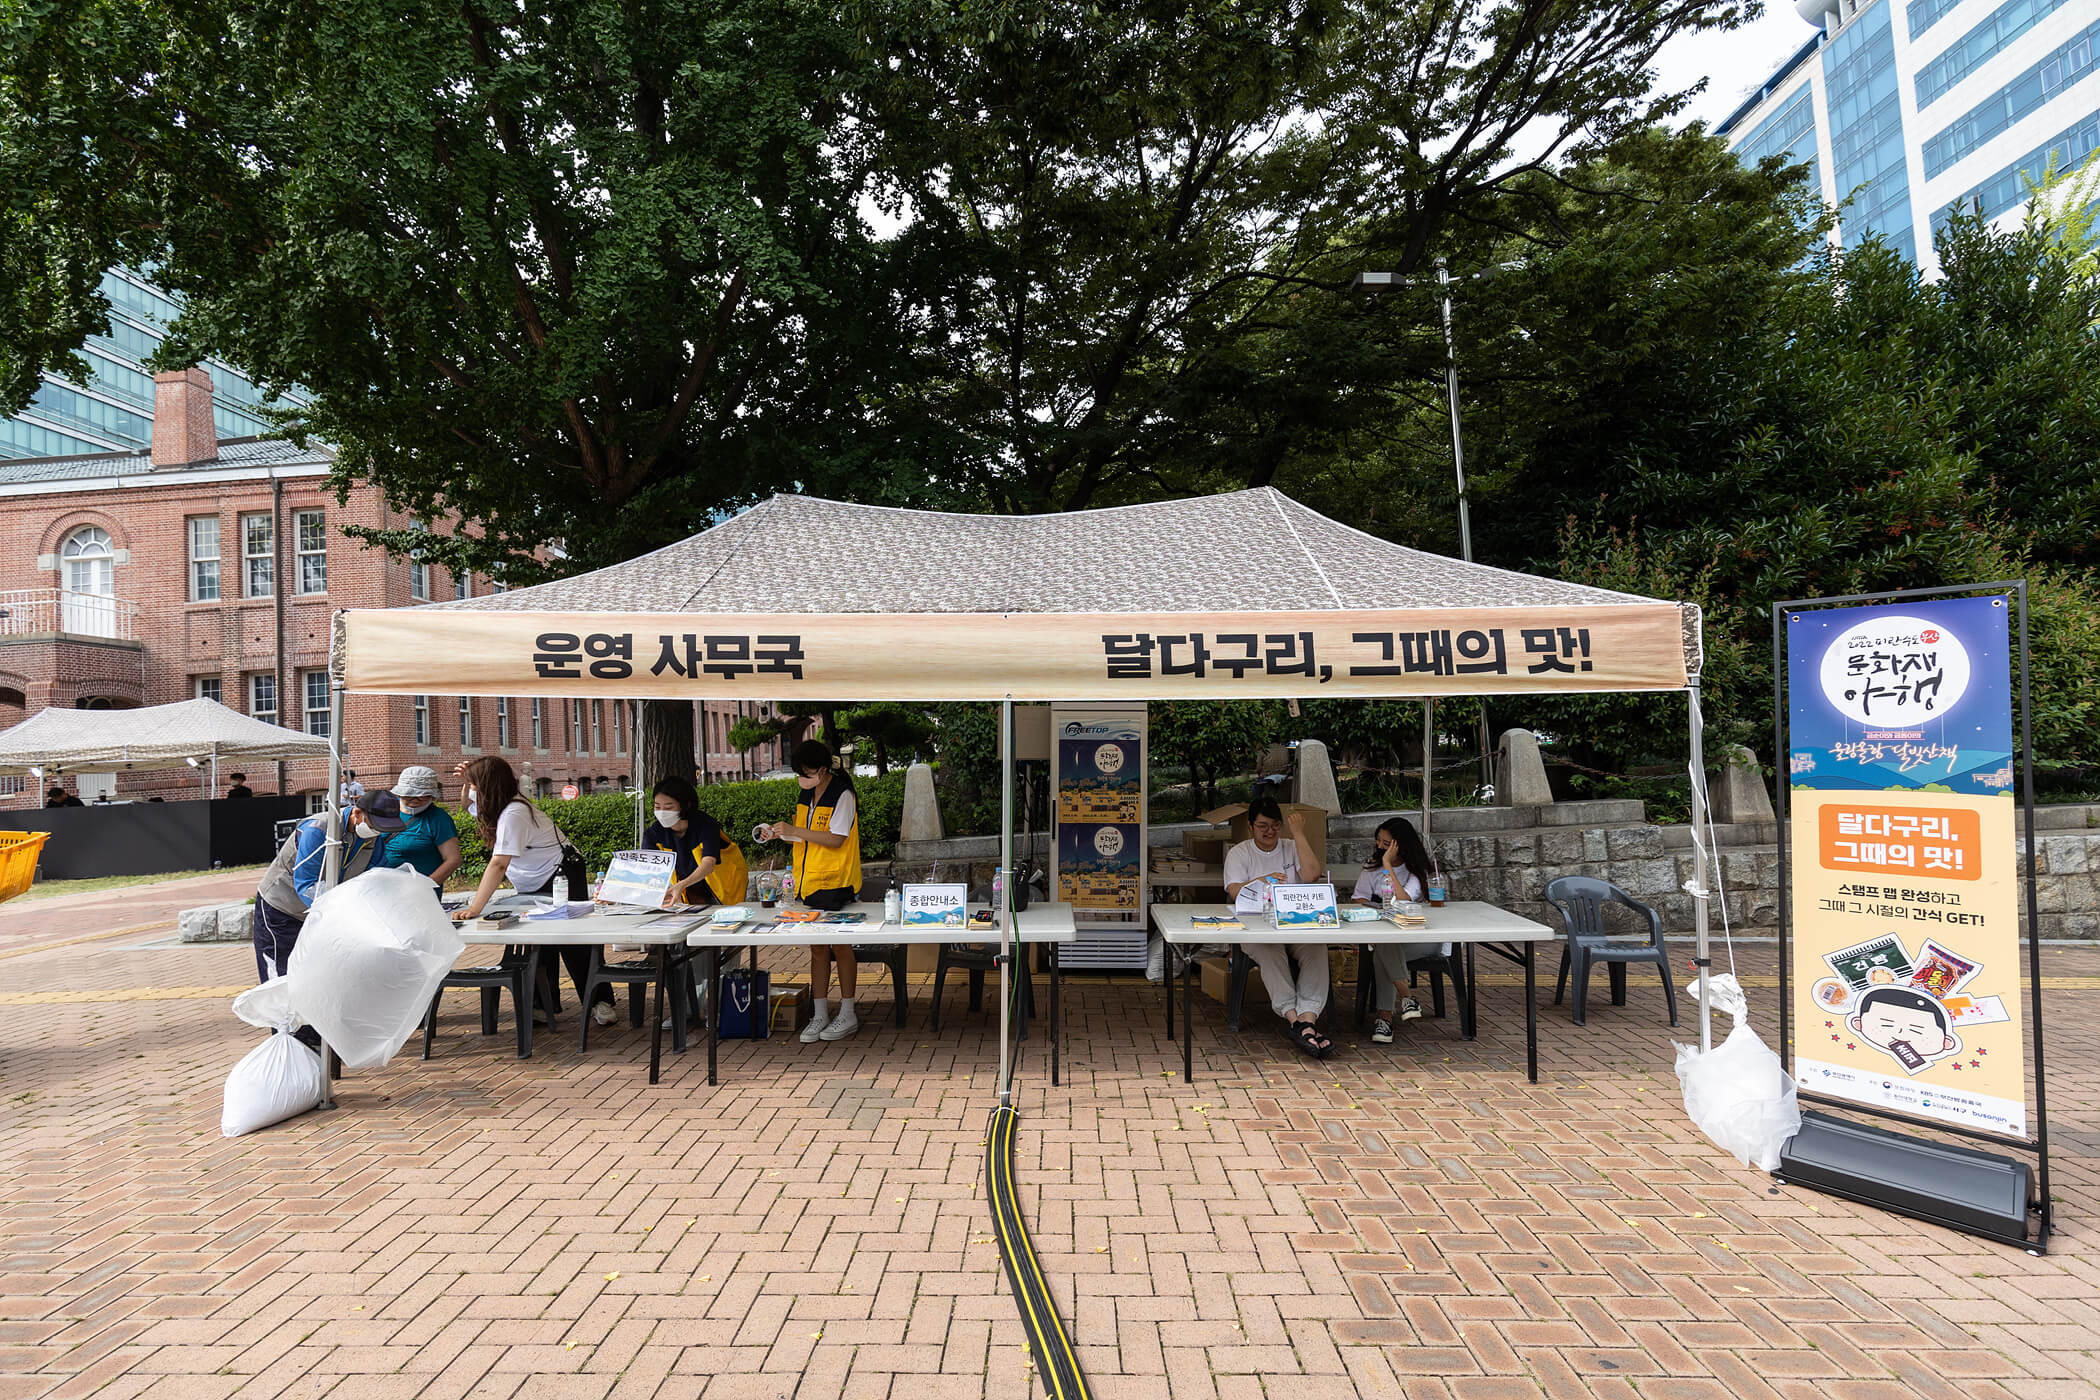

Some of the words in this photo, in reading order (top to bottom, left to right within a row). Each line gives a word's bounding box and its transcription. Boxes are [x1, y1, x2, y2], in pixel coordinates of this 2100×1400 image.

[1101, 631, 1333, 683] 달다구리,
[1350, 628, 1508, 676] 그때의
[1520, 627, 1593, 674] 맛!
[1848, 641, 1873, 649] 2022
[1875, 635, 1920, 647] 피란수도
[532, 632, 633, 680] 운영
[650, 633, 805, 680] 사무국
[1847, 651, 1937, 676] 문화재
[1844, 668, 1943, 716] 야행
[1066, 725, 1109, 735] FREETOP
[1837, 812, 1959, 841] 달다구리.
[650, 855, 671, 866] 조사
[1833, 841, 1915, 867] 그때의
[1923, 846, 1964, 870] 맛!
[909, 895, 959, 907] 종합안내소
[1838, 884, 1880, 898] 스탬프
[1883, 887, 1897, 900] 맵
[1901, 889, 1962, 906] 완성하고
[1819, 899, 1846, 912] 그때
[1849, 902, 1866, 914] 그
[1866, 904, 1909, 919] 시절의
[1912, 908, 1942, 922] 간식
[1946, 912, 1985, 927] GET!
